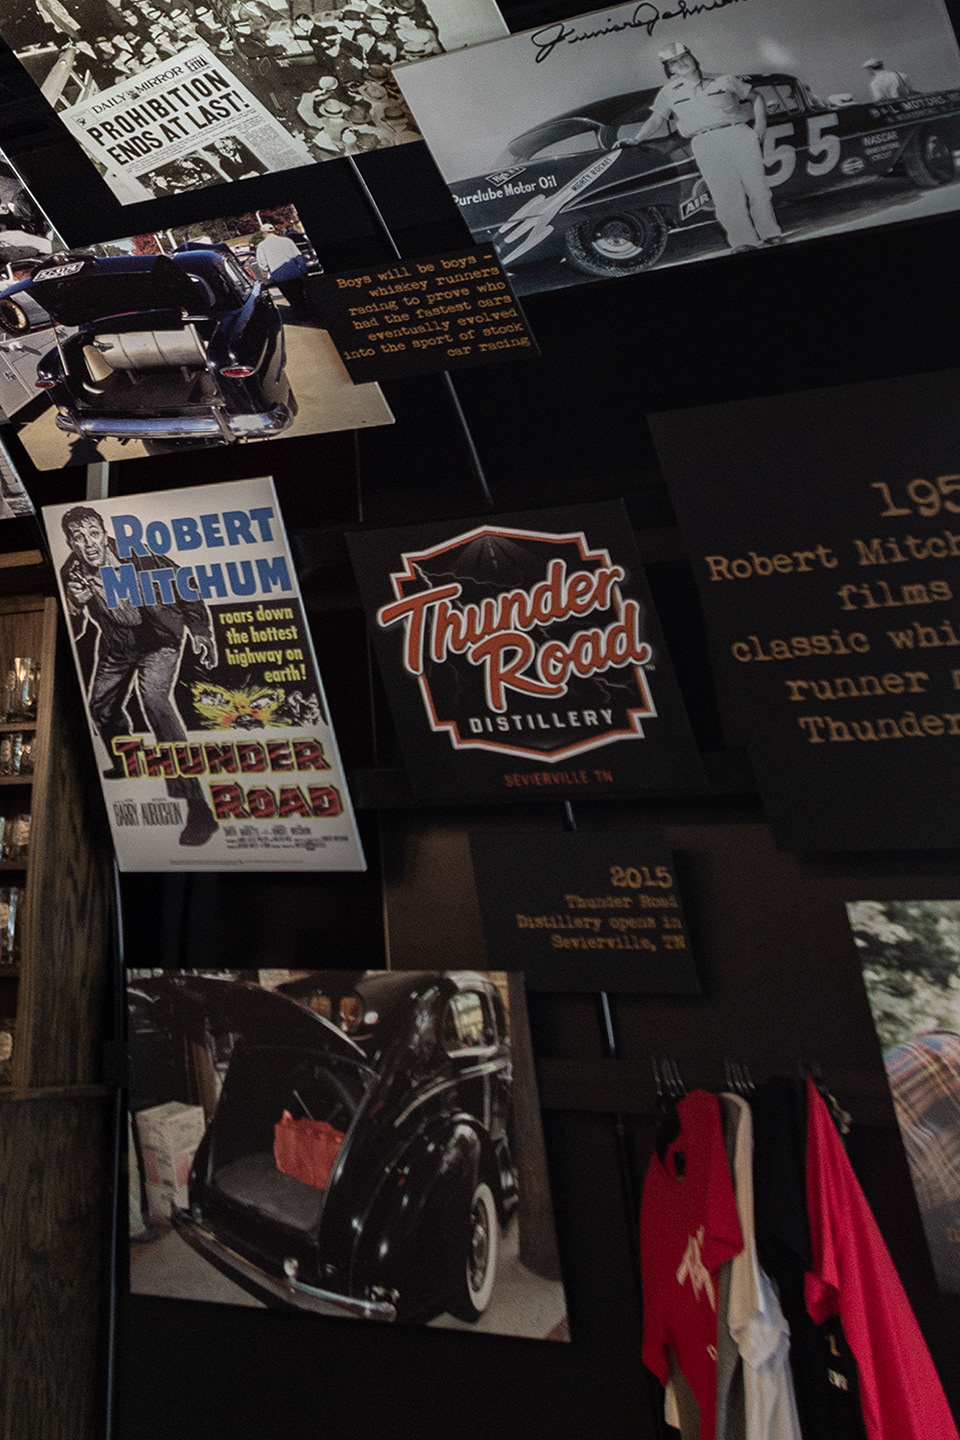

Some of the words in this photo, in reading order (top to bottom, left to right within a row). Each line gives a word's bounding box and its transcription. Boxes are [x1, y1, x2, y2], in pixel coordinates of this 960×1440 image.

[91, 92, 128, 114] DAILY
[136, 66, 184, 95] MIRROR
[87, 70, 231, 147] PROHIBITION
[107, 131, 164, 166] ENDS
[161, 116, 190, 143] AT
[184, 90, 251, 130] LAST!
[862, 130, 899, 147] NASCAR
[763, 113, 841, 188] 55
[503, 181, 538, 198] Motor
[538, 175, 558, 190] Oil
[336, 273, 372, 289] Boys
[377, 267, 412, 282] will
[441, 254, 477, 269] boys
[368, 278, 428, 298] whiskey
[435, 266, 500, 286] runners
[348, 299, 399, 317] racing
[426, 287, 470, 305] prove
[416, 301, 472, 319] fastest
[477, 294, 512, 307] cars
[368, 320, 451, 342] eventually
[457, 308, 519, 326] evolved
[343, 347, 376, 360] into
[412, 333, 453, 350] sport
[483, 322, 524, 337] stock
[479, 336, 531, 352] racing
[111, 506, 275, 559] ROBERT
[705, 543, 838, 581] Robert
[100, 556, 294, 608] MITCHUM
[839, 580, 954, 610] films
[219, 610, 253, 625] roars
[256, 606, 293, 622] down
[377, 558, 625, 676] Thunder
[226, 629, 249, 643] the
[252, 626, 298, 641] hottest
[731, 628, 870, 663] classic
[225, 648, 283, 667] highway
[285, 648, 303, 661] on
[467, 599, 652, 713] Road
[264, 665, 307, 682] earth!
[785, 670, 929, 701] runner
[469, 709, 615, 734] DISTILLERY
[112, 735, 333, 779] THUNDER
[503, 770, 590, 788] SEVIERVILLE
[208, 780, 345, 822] ROAD
[609, 865, 673, 889] 2015
[563, 893, 633, 909] Thunder
[638, 893, 679, 909] Road
[515, 913, 602, 933] Distillery
